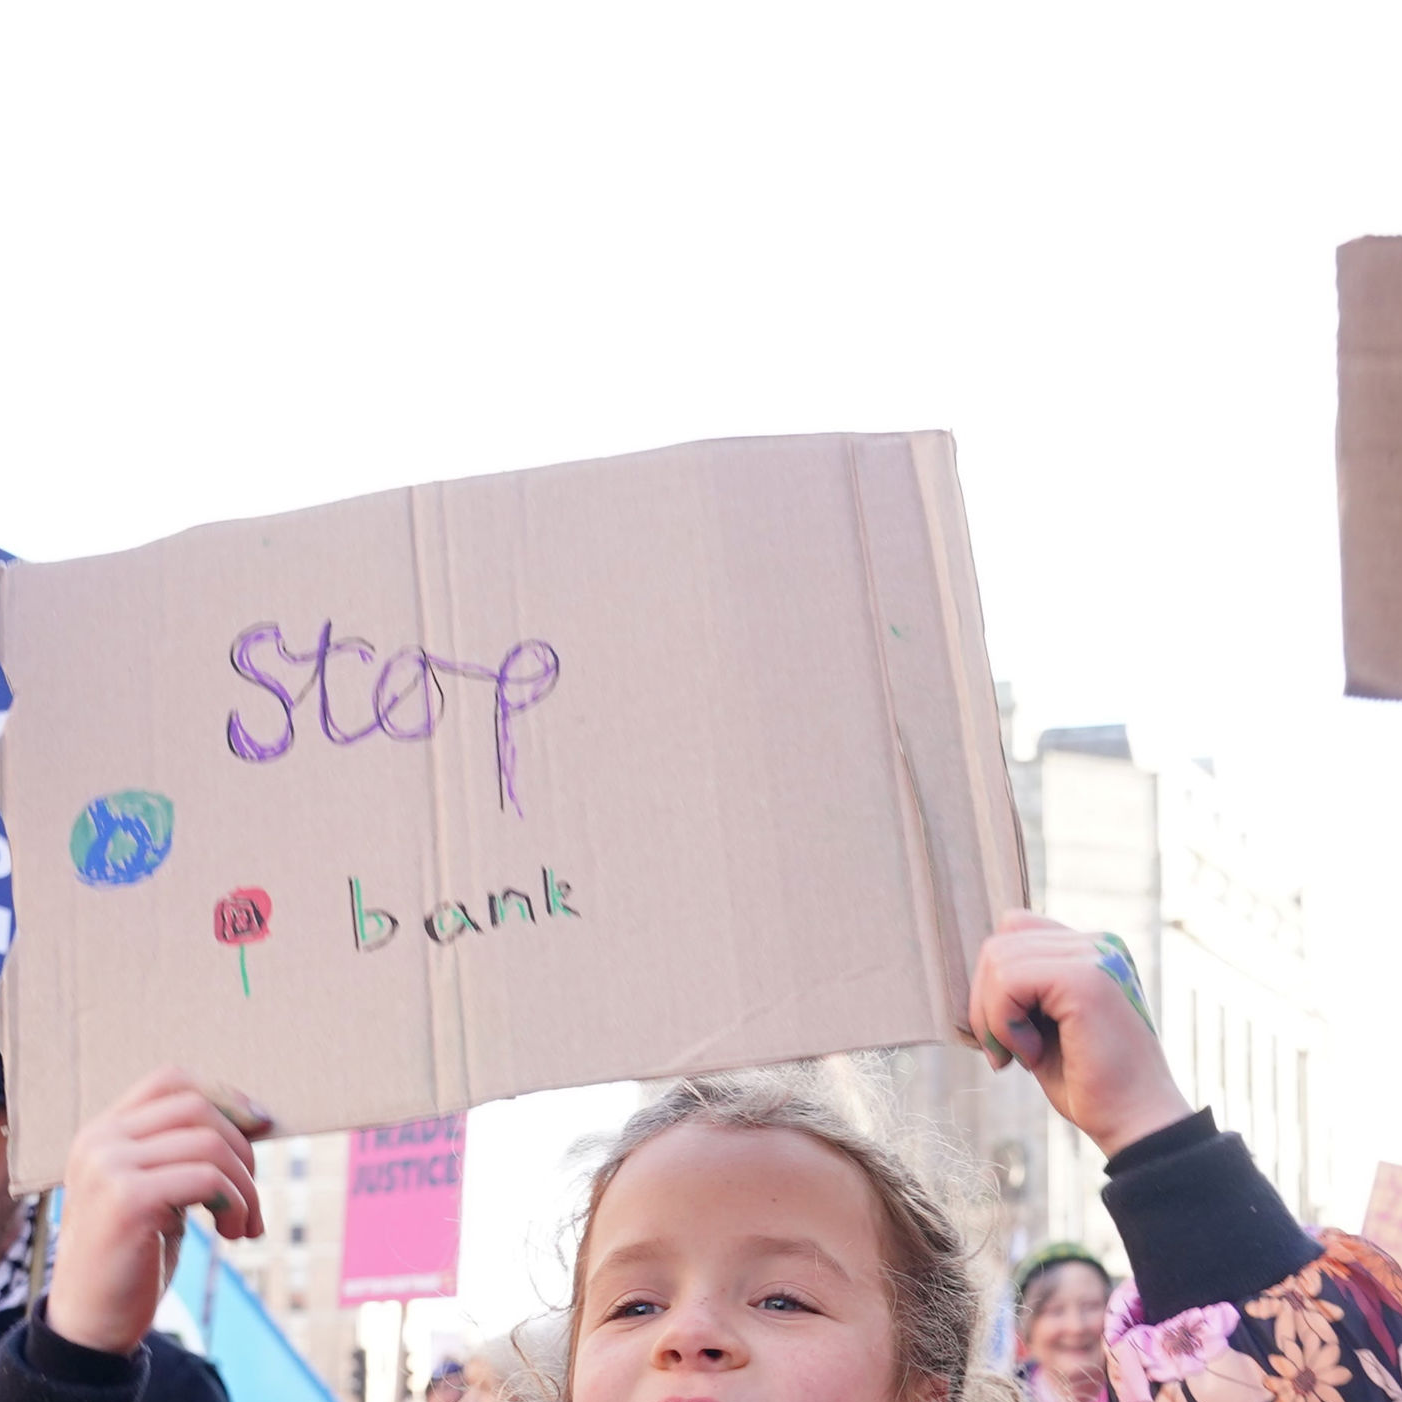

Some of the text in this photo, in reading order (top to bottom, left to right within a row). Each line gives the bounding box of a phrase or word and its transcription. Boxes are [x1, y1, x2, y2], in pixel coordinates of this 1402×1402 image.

[225, 616, 560, 820] Stop
[347, 865, 582, 953] bank
[352, 1152, 460, 1195] JUSTICE
